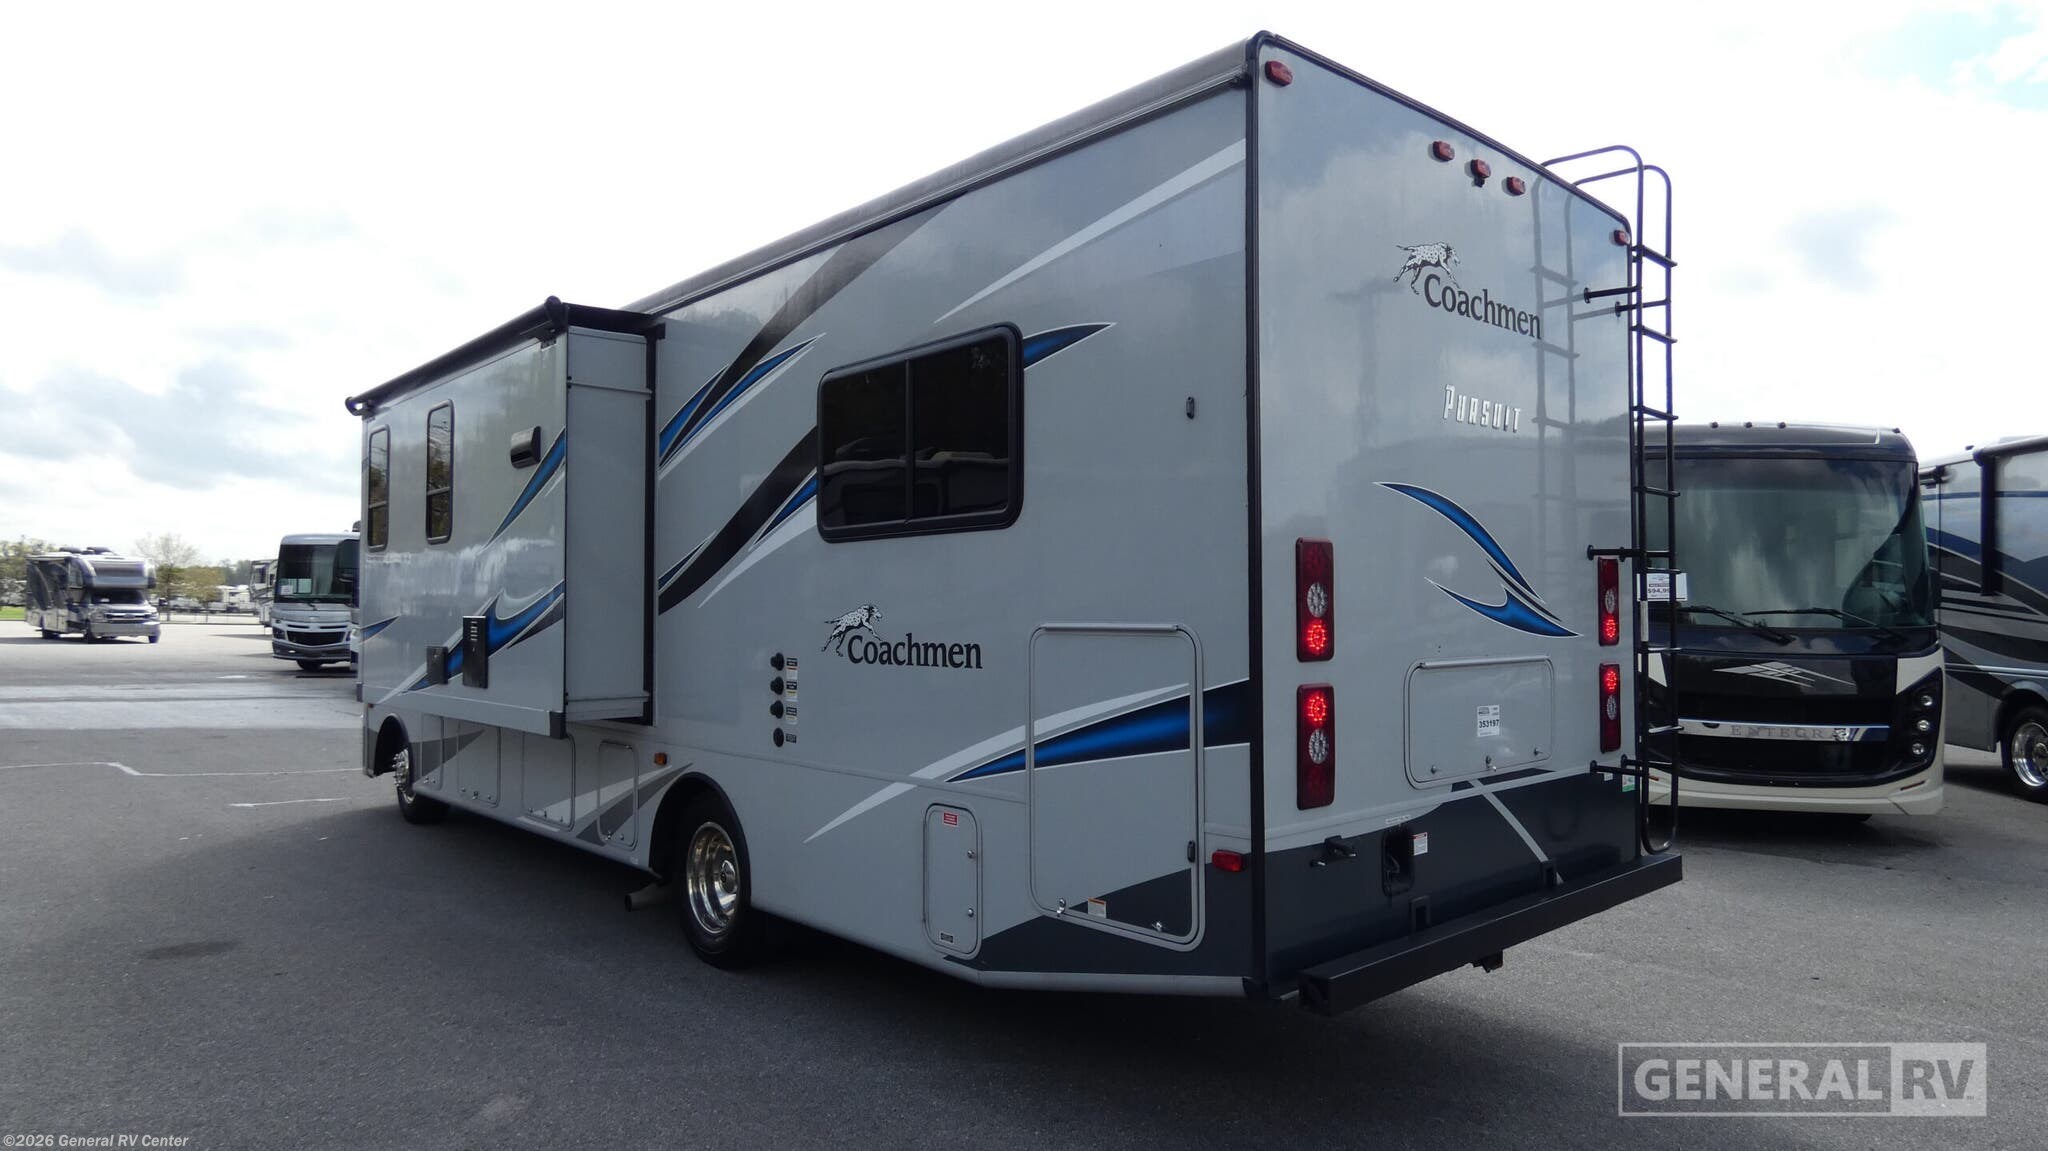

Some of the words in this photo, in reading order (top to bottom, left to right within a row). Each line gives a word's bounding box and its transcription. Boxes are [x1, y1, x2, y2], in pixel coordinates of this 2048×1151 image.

[1424, 273, 1542, 340] Coachmen
[1443, 384, 1521, 433] PURSUIT
[847, 632, 983, 669] Coachmen
